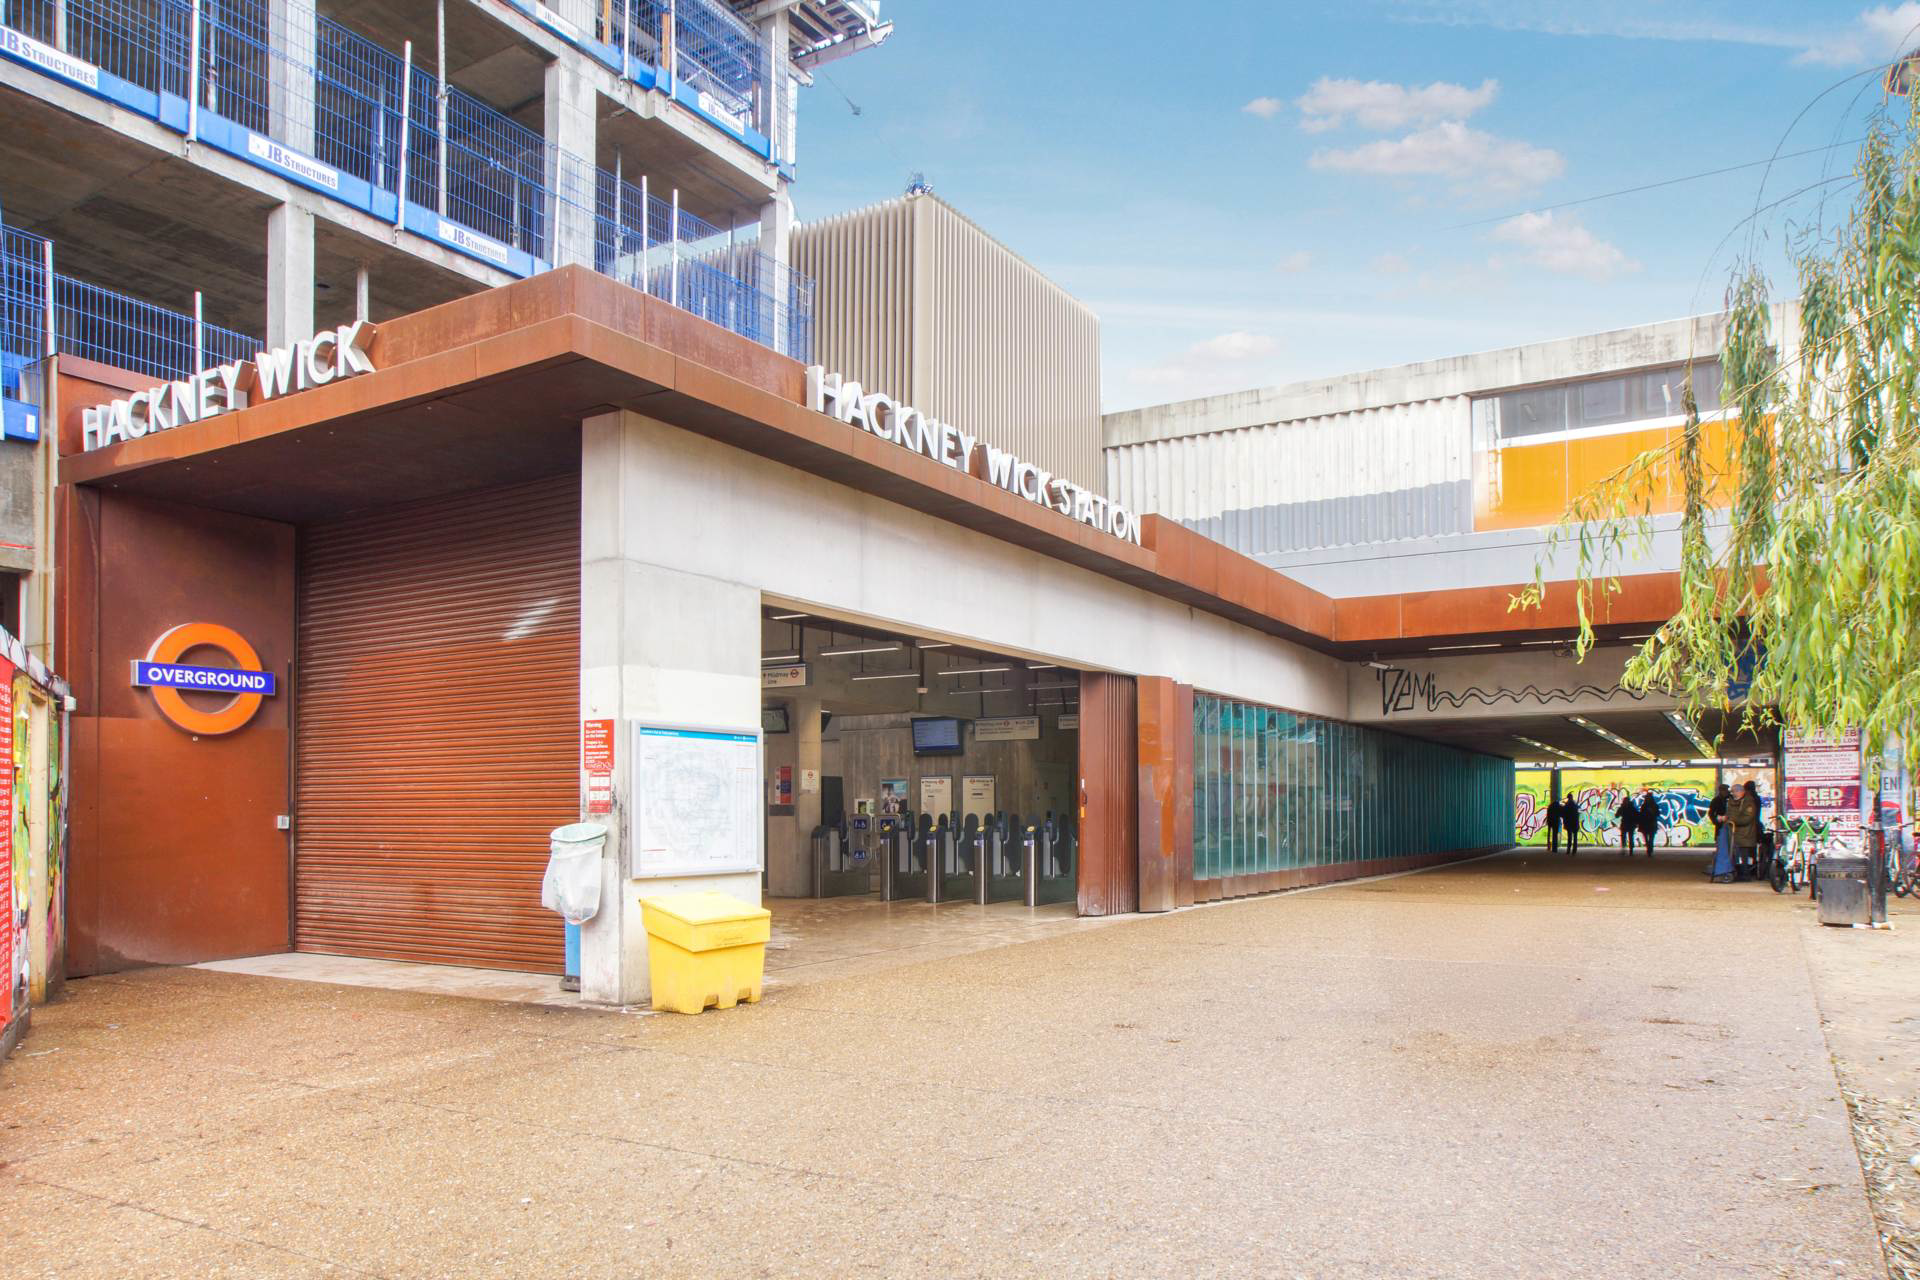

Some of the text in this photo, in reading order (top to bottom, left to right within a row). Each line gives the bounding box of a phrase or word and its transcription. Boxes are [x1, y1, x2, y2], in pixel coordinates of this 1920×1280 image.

[268, 144, 283, 163] JB
[454, 228, 465, 245] JB
[81, 320, 376, 452] HACKNEY WICK
[806, 365, 1142, 547] HACKNEY WICK STATION
[147, 667, 266, 689] OVERGROUND
[1807, 787, 1844, 800] RED
